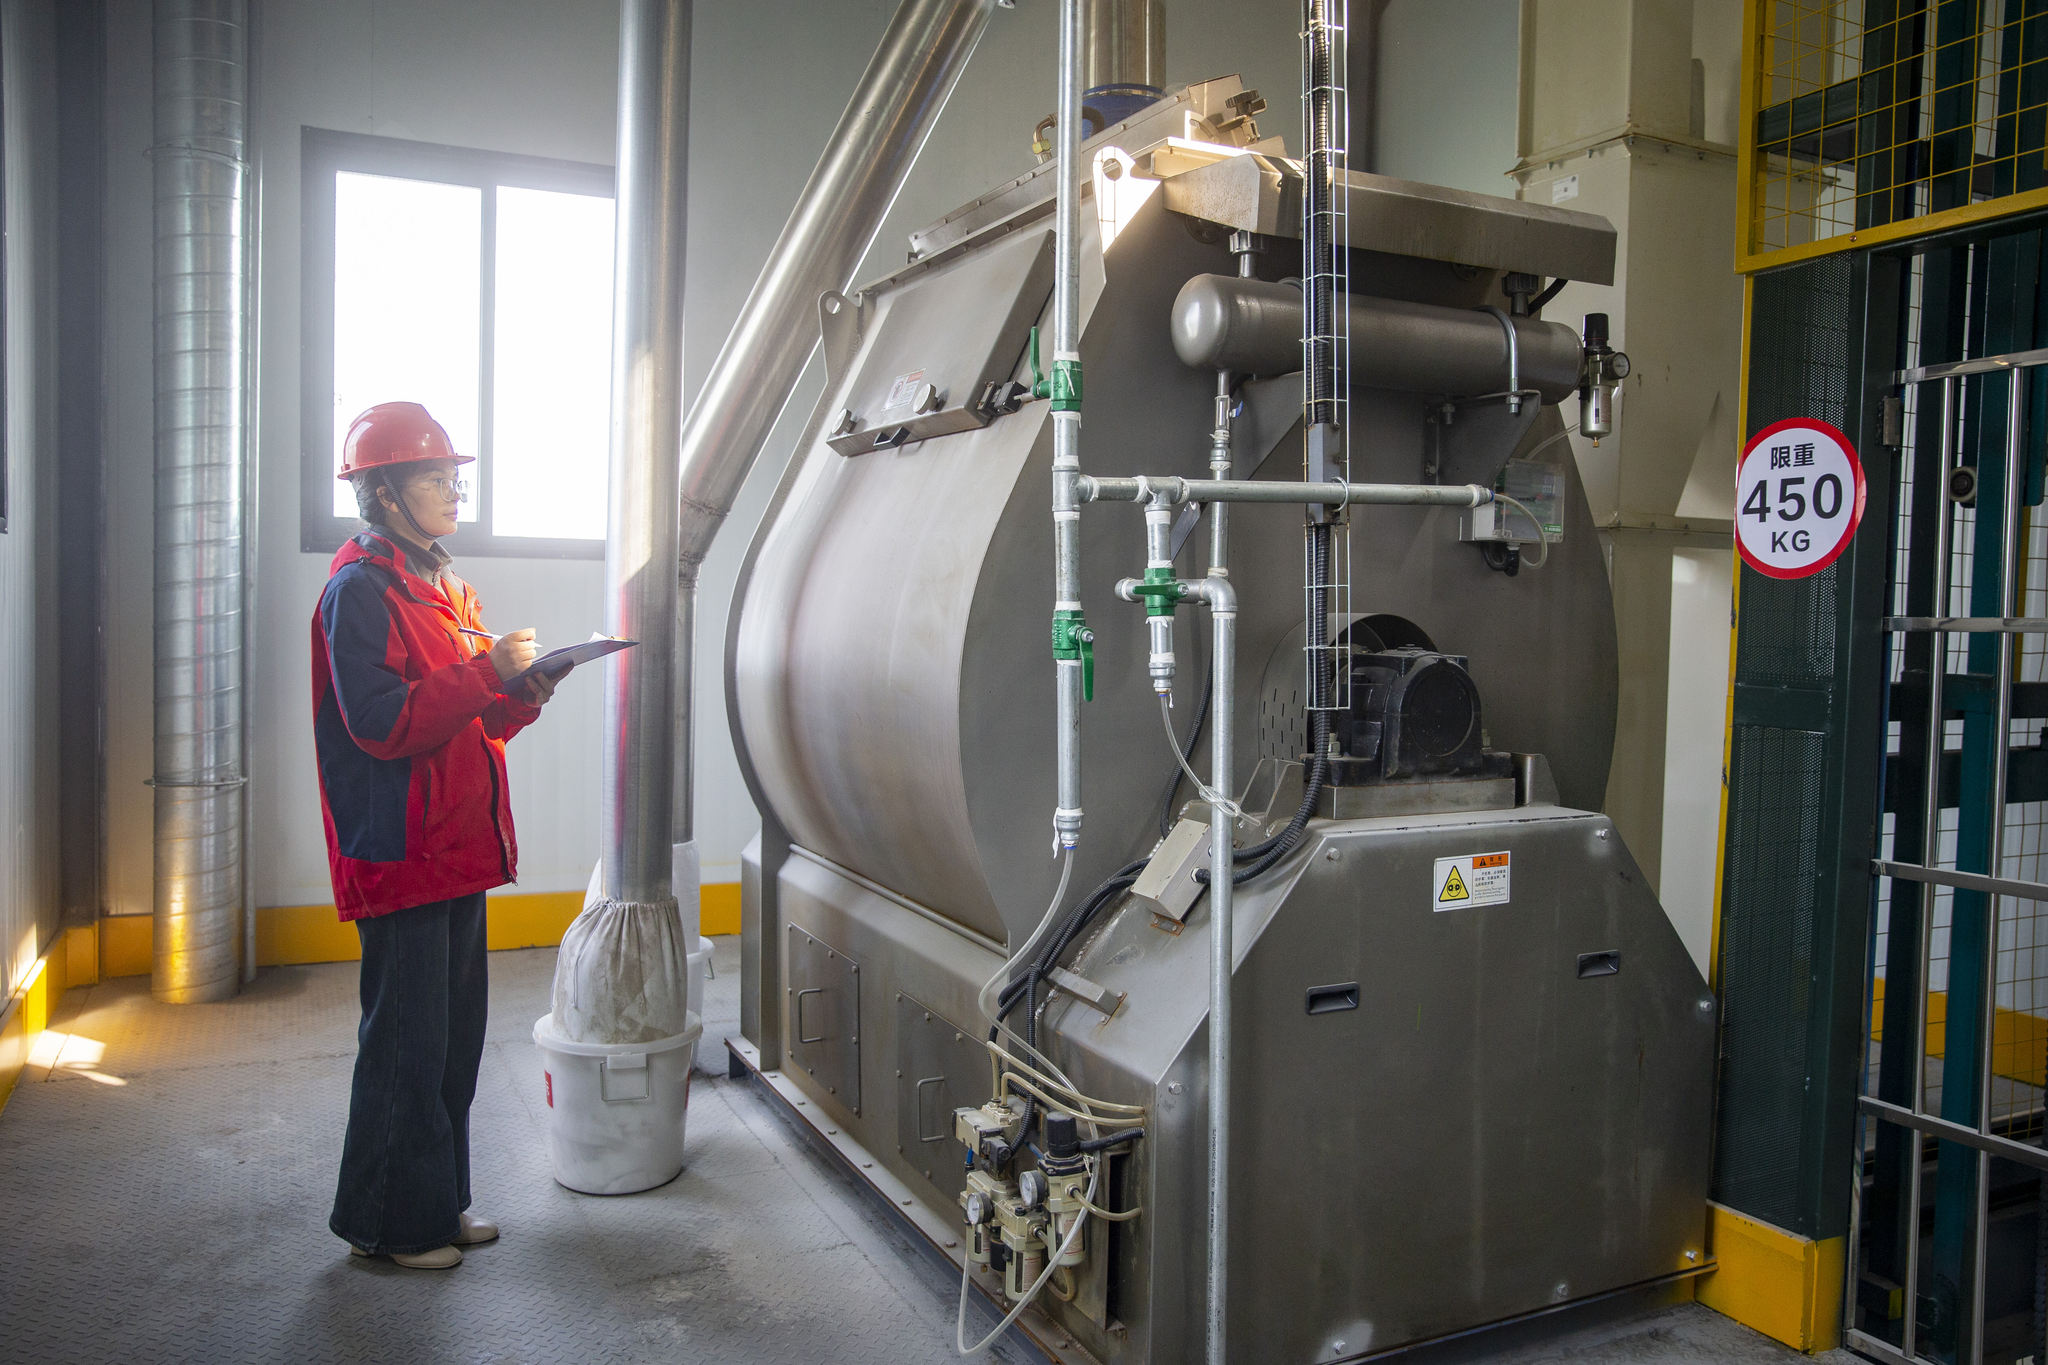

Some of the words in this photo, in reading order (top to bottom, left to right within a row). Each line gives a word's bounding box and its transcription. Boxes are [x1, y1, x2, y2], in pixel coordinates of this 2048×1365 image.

[1770, 442, 1815, 470] 限重
[1742, 473, 1843, 523] 450
[1771, 529, 1810, 553] KG
